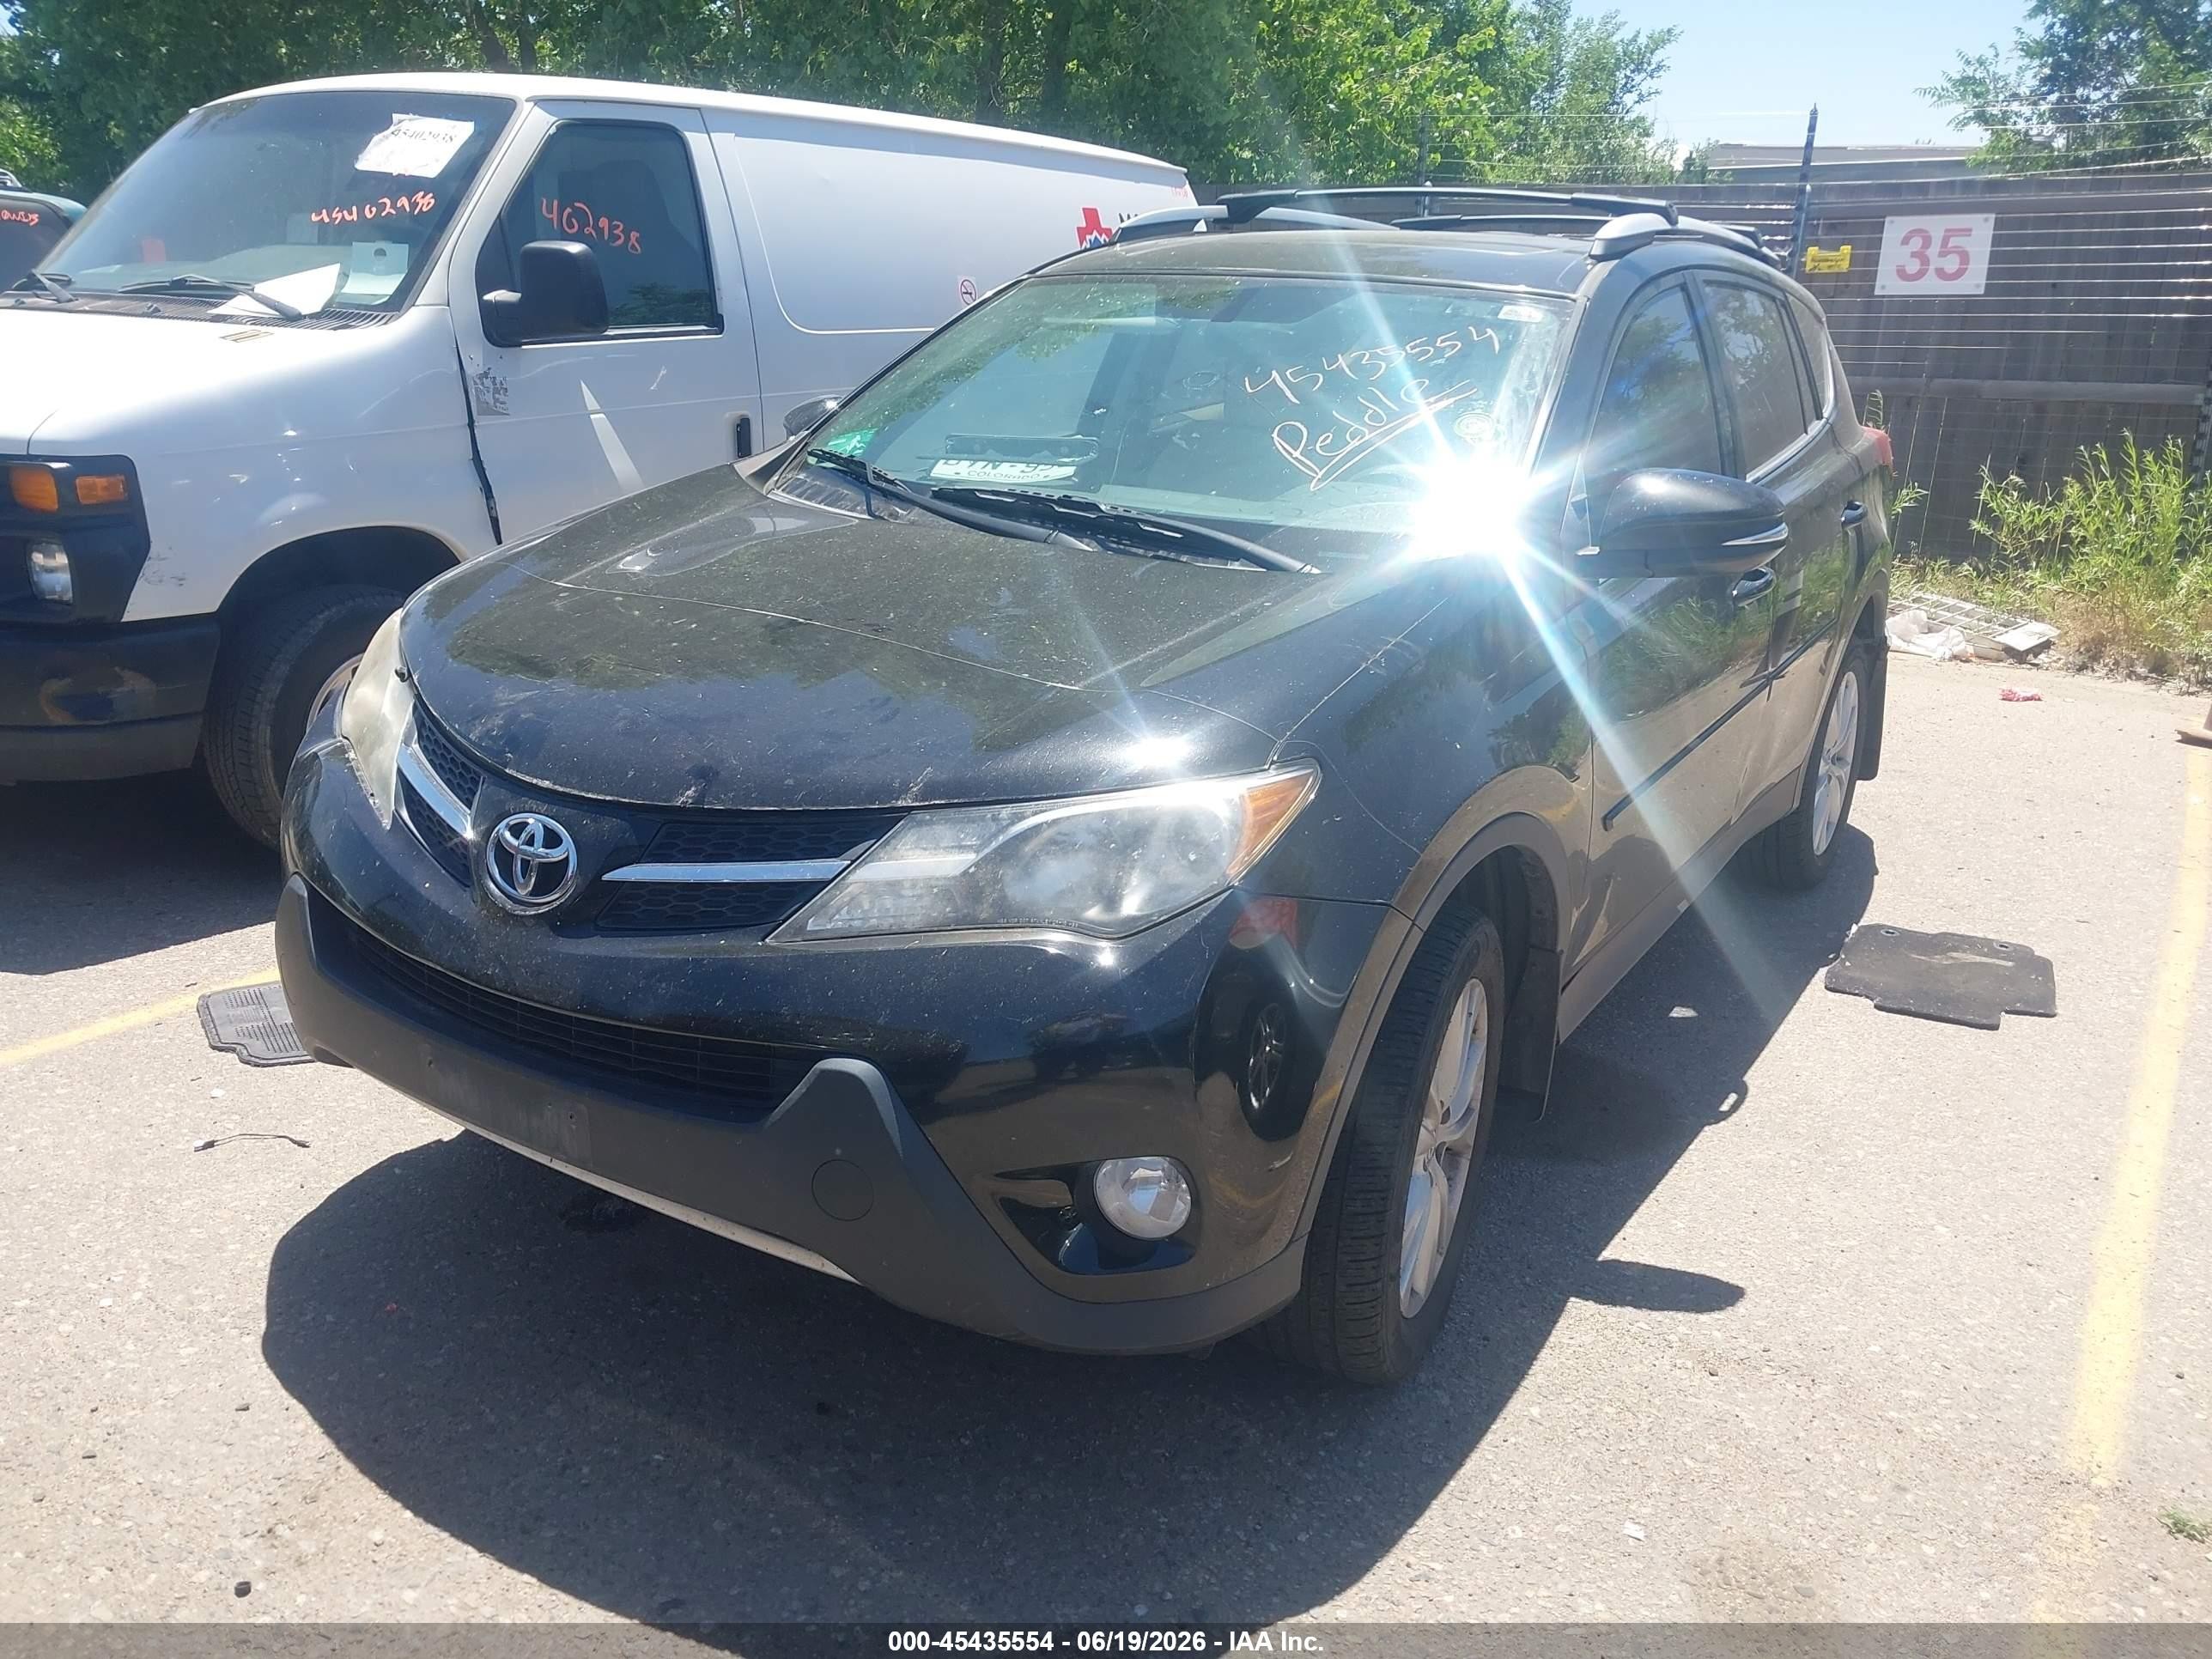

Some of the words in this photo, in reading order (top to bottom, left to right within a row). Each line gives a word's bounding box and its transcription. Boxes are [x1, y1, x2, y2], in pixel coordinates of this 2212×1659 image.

[541, 197, 641, 254] 402938
[1895, 228, 1973, 283] 35
[1245, 325, 1499, 404] 45435554
[967, 470, 1040, 480] COLORADO
